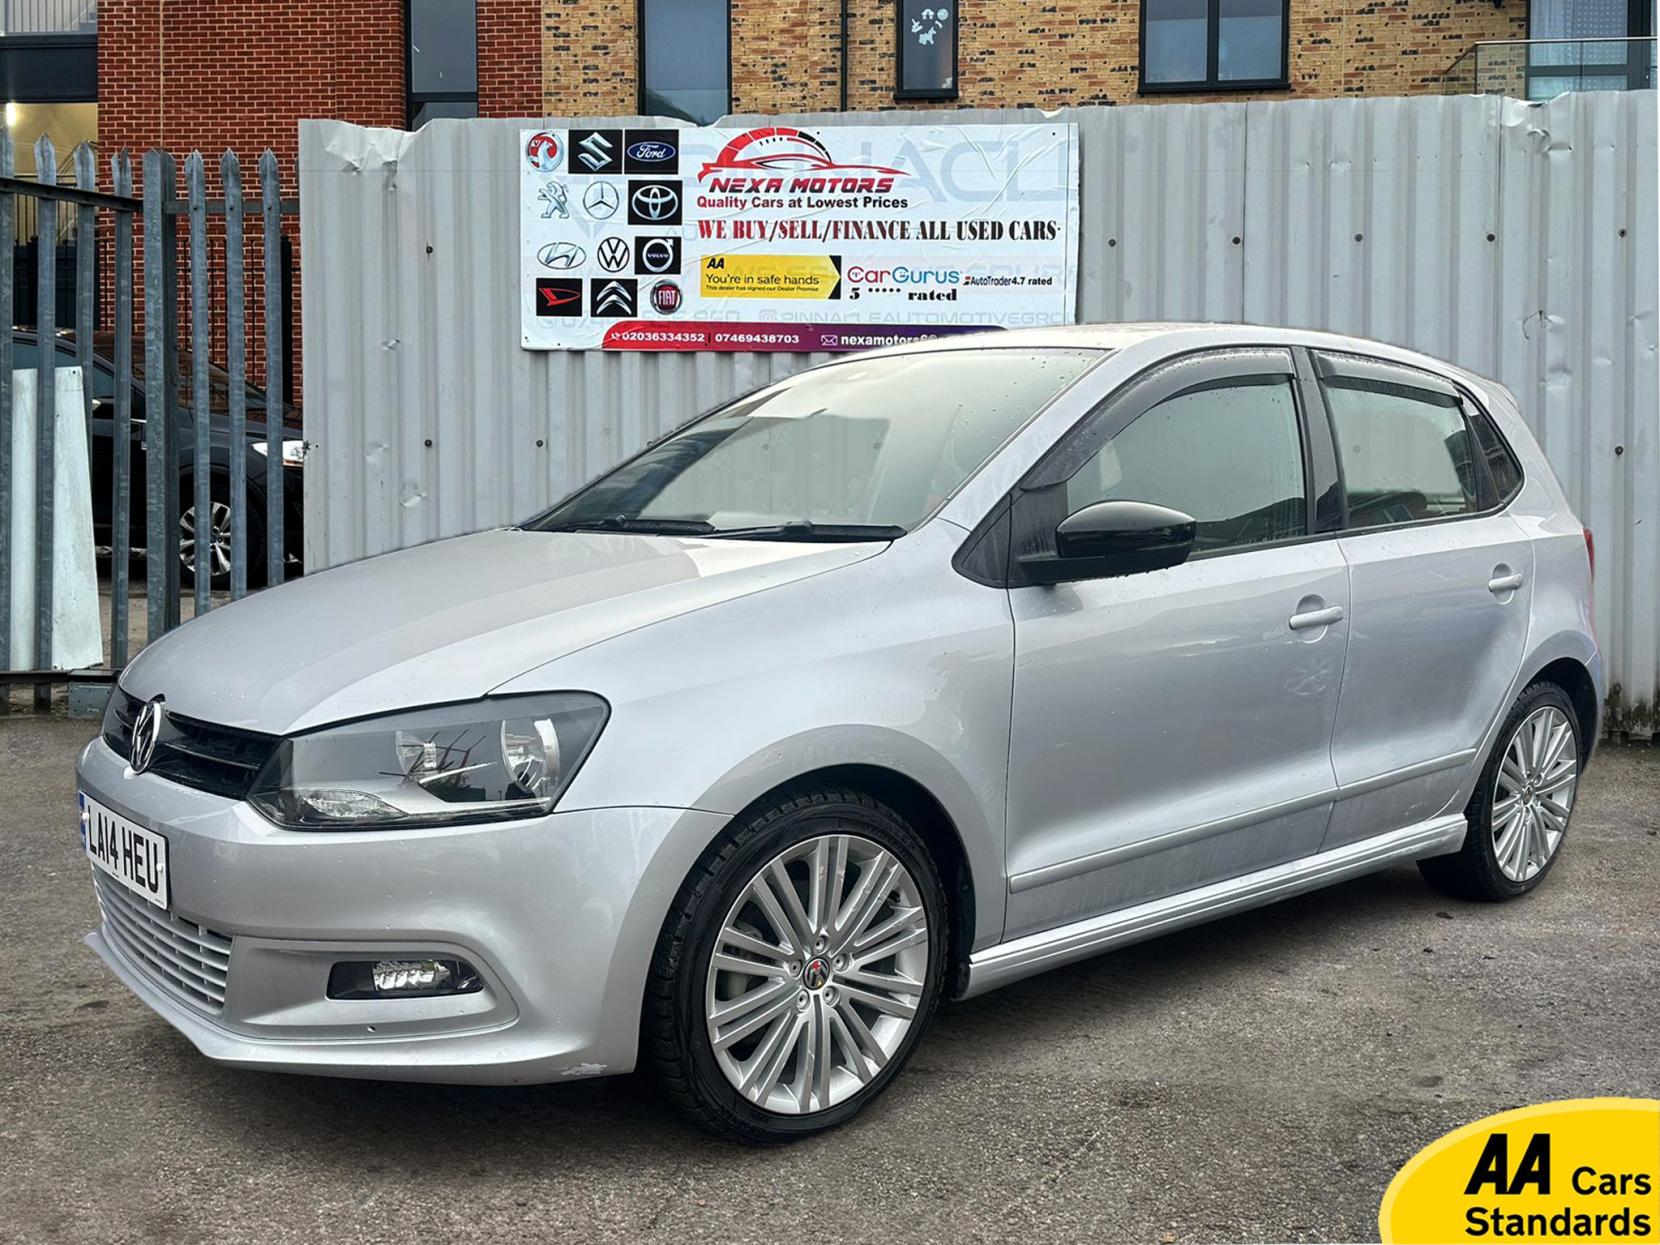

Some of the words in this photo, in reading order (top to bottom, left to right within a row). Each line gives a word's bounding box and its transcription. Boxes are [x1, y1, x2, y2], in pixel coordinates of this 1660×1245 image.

[636, 143, 665, 159] Ford
[709, 177, 783, 193] NEXA
[789, 177, 894, 193] MOTORS
[697, 196, 747, 210] Quality
[751, 196, 784, 208] Cars
[788, 197, 803, 208] at
[807, 196, 859, 208] Lowest
[863, 196, 908, 208] Prices
[698, 220, 727, 240] WE
[916, 220, 951, 241] ALL
[956, 220, 1004, 241] USED
[706, 257, 725, 269] AA
[706, 274, 741, 284] You're
[744, 273, 754, 284] in
[757, 273, 781, 285] safe
[783, 274, 820, 286] hands
[847, 266, 960, 284] CarGurus
[1027, 277, 1053, 286] rated
[748, 285, 766, 293] signed
[849, 287, 860, 300] 5
[908, 288, 958, 301] rated
[658, 290, 676, 305] FIAT
[622, 333, 705, 343] 02036334352
[715, 334, 800, 344] 07469438703
[88, 805, 118, 870] LA14
[122, 826, 159, 894] HEU
